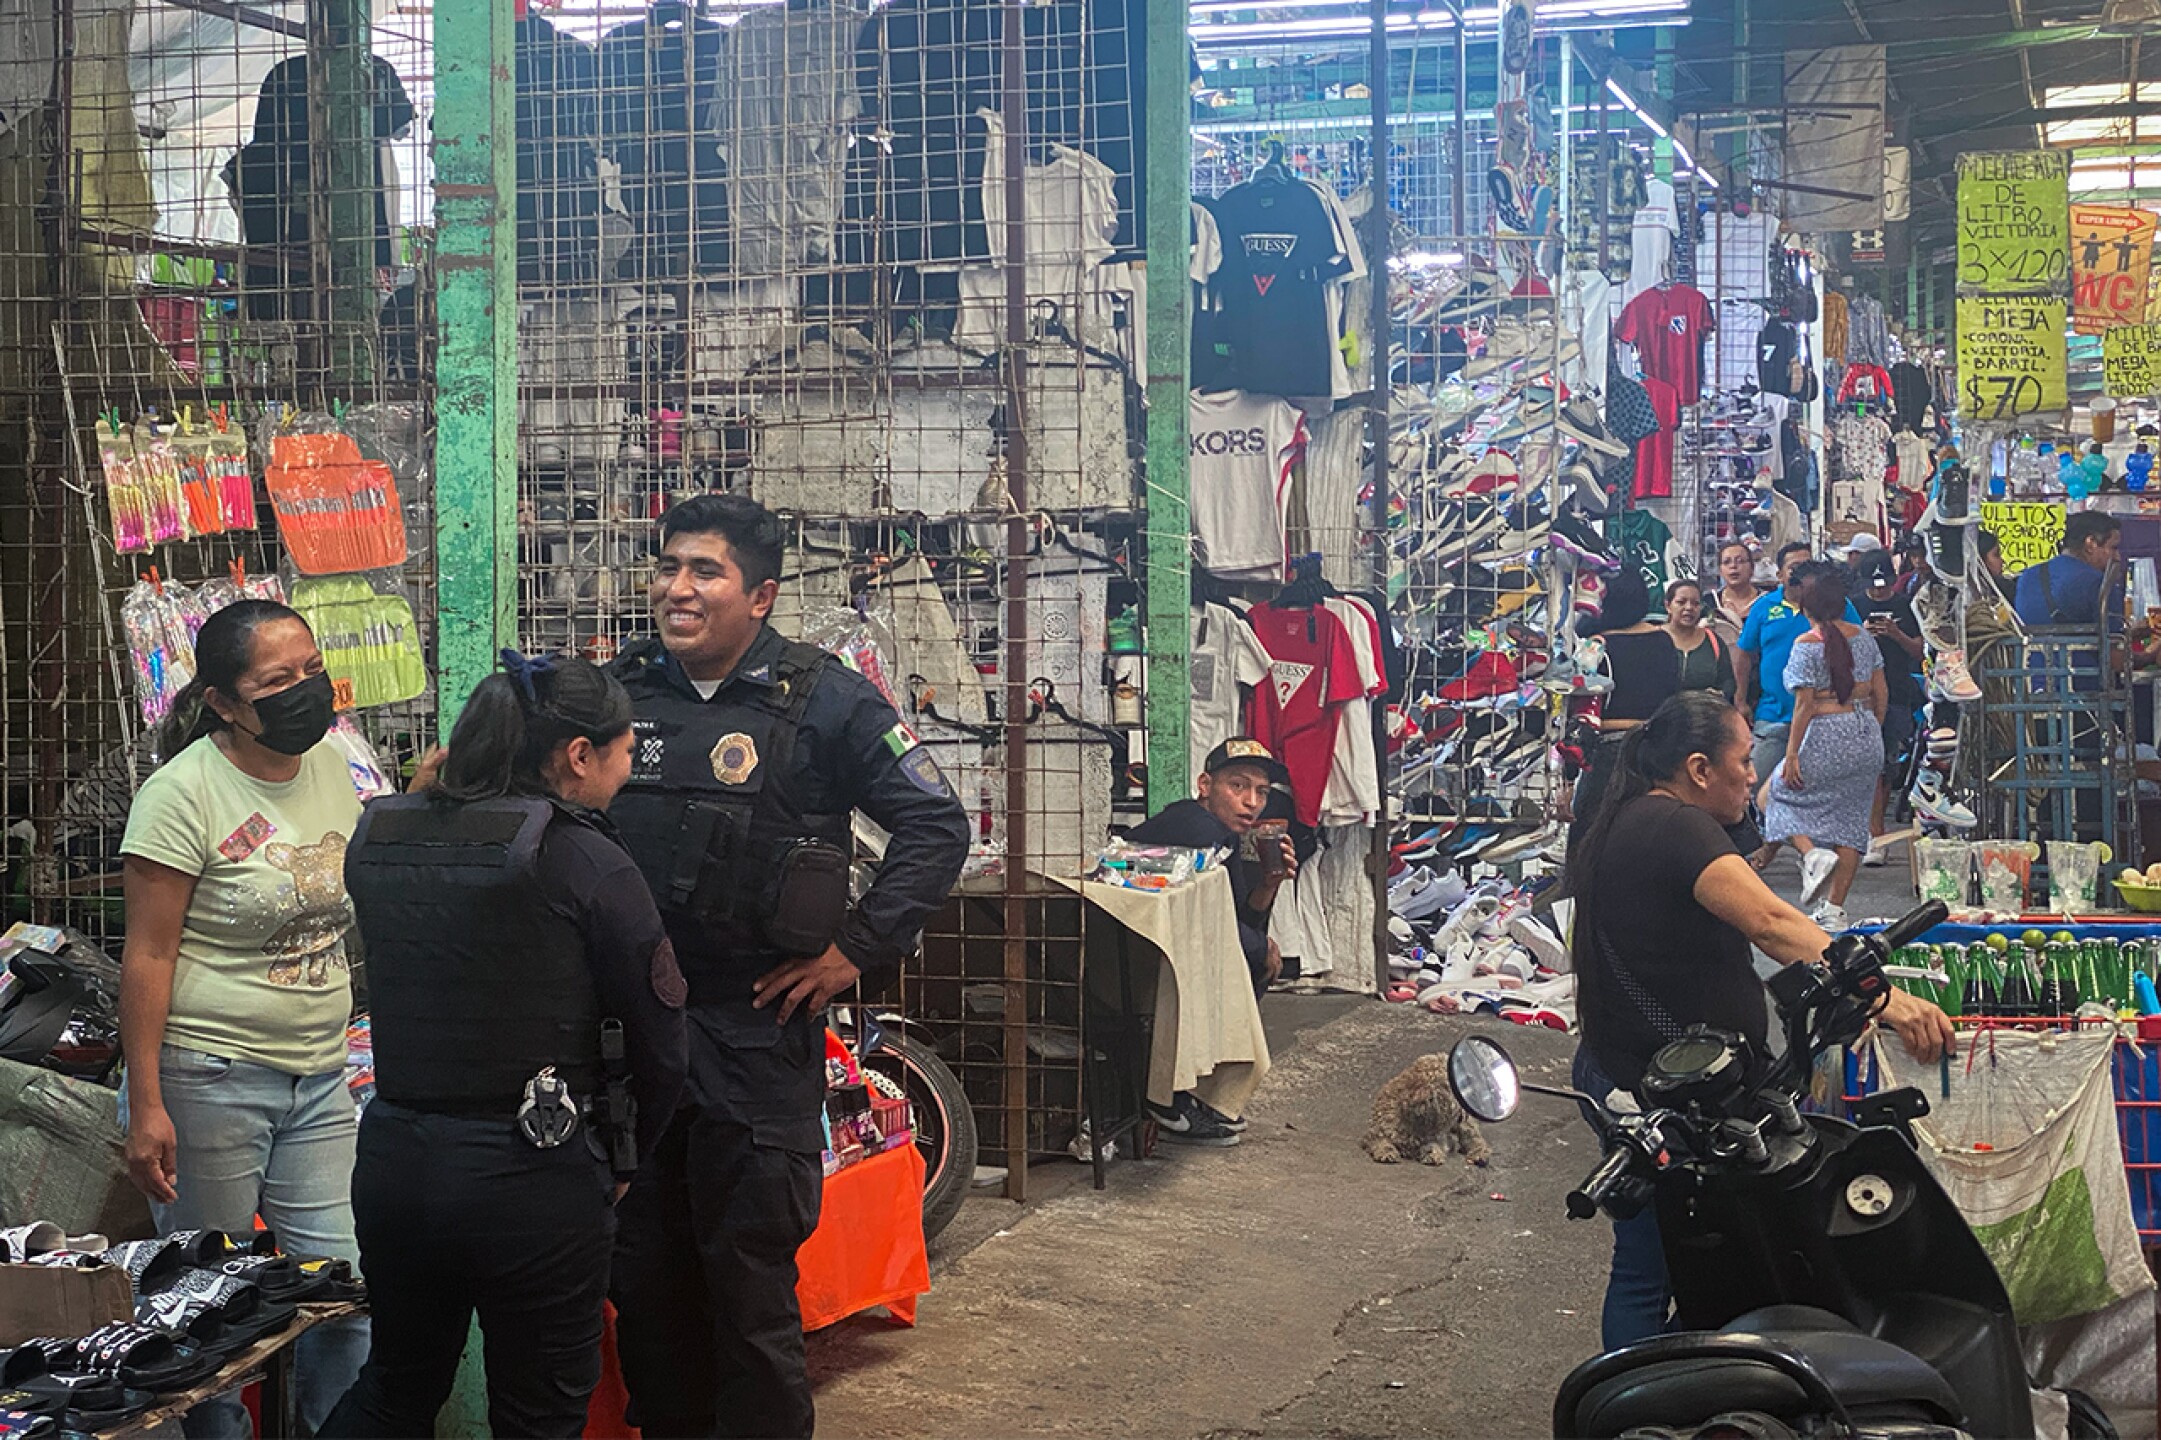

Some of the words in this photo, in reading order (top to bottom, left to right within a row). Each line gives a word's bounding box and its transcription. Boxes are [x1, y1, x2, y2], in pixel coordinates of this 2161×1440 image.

[1995, 184, 2026, 205] DE
[1966, 204, 2042, 223] LITRO
[1964, 223, 2057, 239] VICTORIA
[1247, 239, 1289, 251] GUESS
[2073, 272, 2134, 312] WC
[1983, 306, 2050, 331] MEGA
[1763, 345, 1776, 361] 7
[2121, 341, 2140, 354] DE
[2106, 370, 2152, 383] LITRO
[1965, 374, 2042, 419] $70
[1189, 427, 1266, 456] KORS
[1980, 504, 2058, 526] ULITOS
[1272, 662, 1307, 677] GUESS
